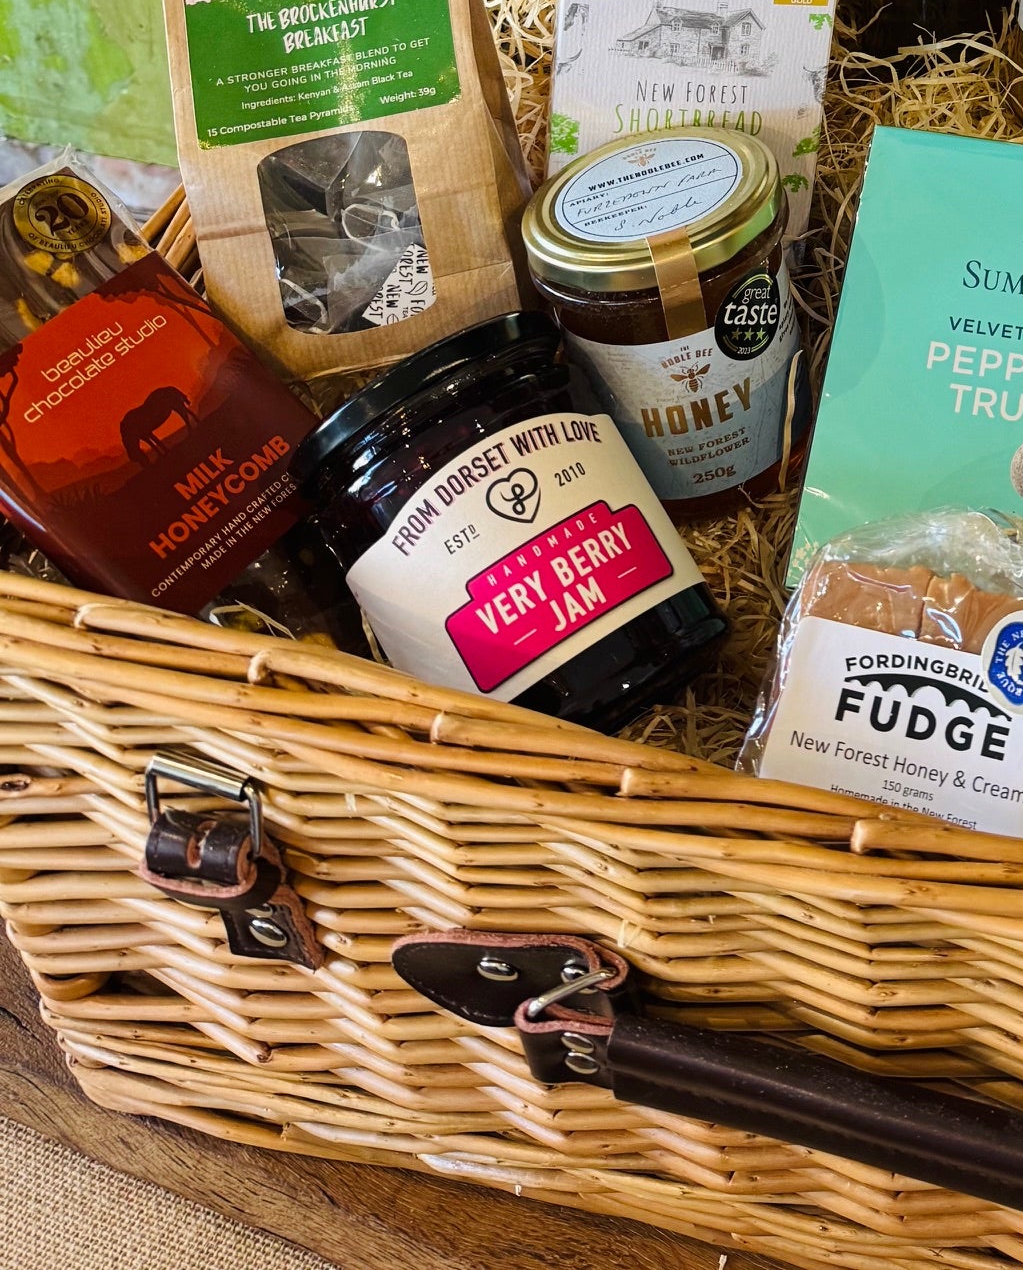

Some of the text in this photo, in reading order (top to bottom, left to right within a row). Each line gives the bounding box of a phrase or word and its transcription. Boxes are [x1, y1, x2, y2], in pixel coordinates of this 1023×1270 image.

[246, 12, 277, 33] THE
[283, 17, 369, 54] BREAKFAST
[227, 43, 407, 85] STRONGER BLEND TO
[272, 72, 321, 89] GOING IN
[241, 94, 296, 110] Ingredients:
[207, 117, 287, 137] 15 Compostable
[588, 153, 705, 192] WWW.THENOBLEBEE.COM
[723, 302, 778, 326] taste
[742, 284, 771, 304] great
[40, 320, 125, 384] beaulieu
[695, 348, 713, 358] BEE
[23, 352, 117, 424] chocolate
[641, 377, 751, 438] HONEY
[434, 421, 602, 507] DORSET LOVE
[667, 446, 694, 456] NEW
[668, 437, 750, 467] WILDFLOWER
[173, 448, 234, 500] MILK
[554, 461, 587, 488] 2010
[149, 435, 291, 560] HONEYCOMB
[225, 507, 272, 548] IN NEW
[151, 533, 222, 598] CONTEMPORARY
[487, 512, 599, 587] HANDMADE
[475, 521, 634, 636] VERY BERRY
[549, 578, 608, 632] JAM
[835, 688, 1010, 762] FUDGE
[790, 730, 830, 755] New
[834, 741, 889, 770] Forest
[893, 755, 949, 788] Honey
[882, 780, 901, 795] 150
